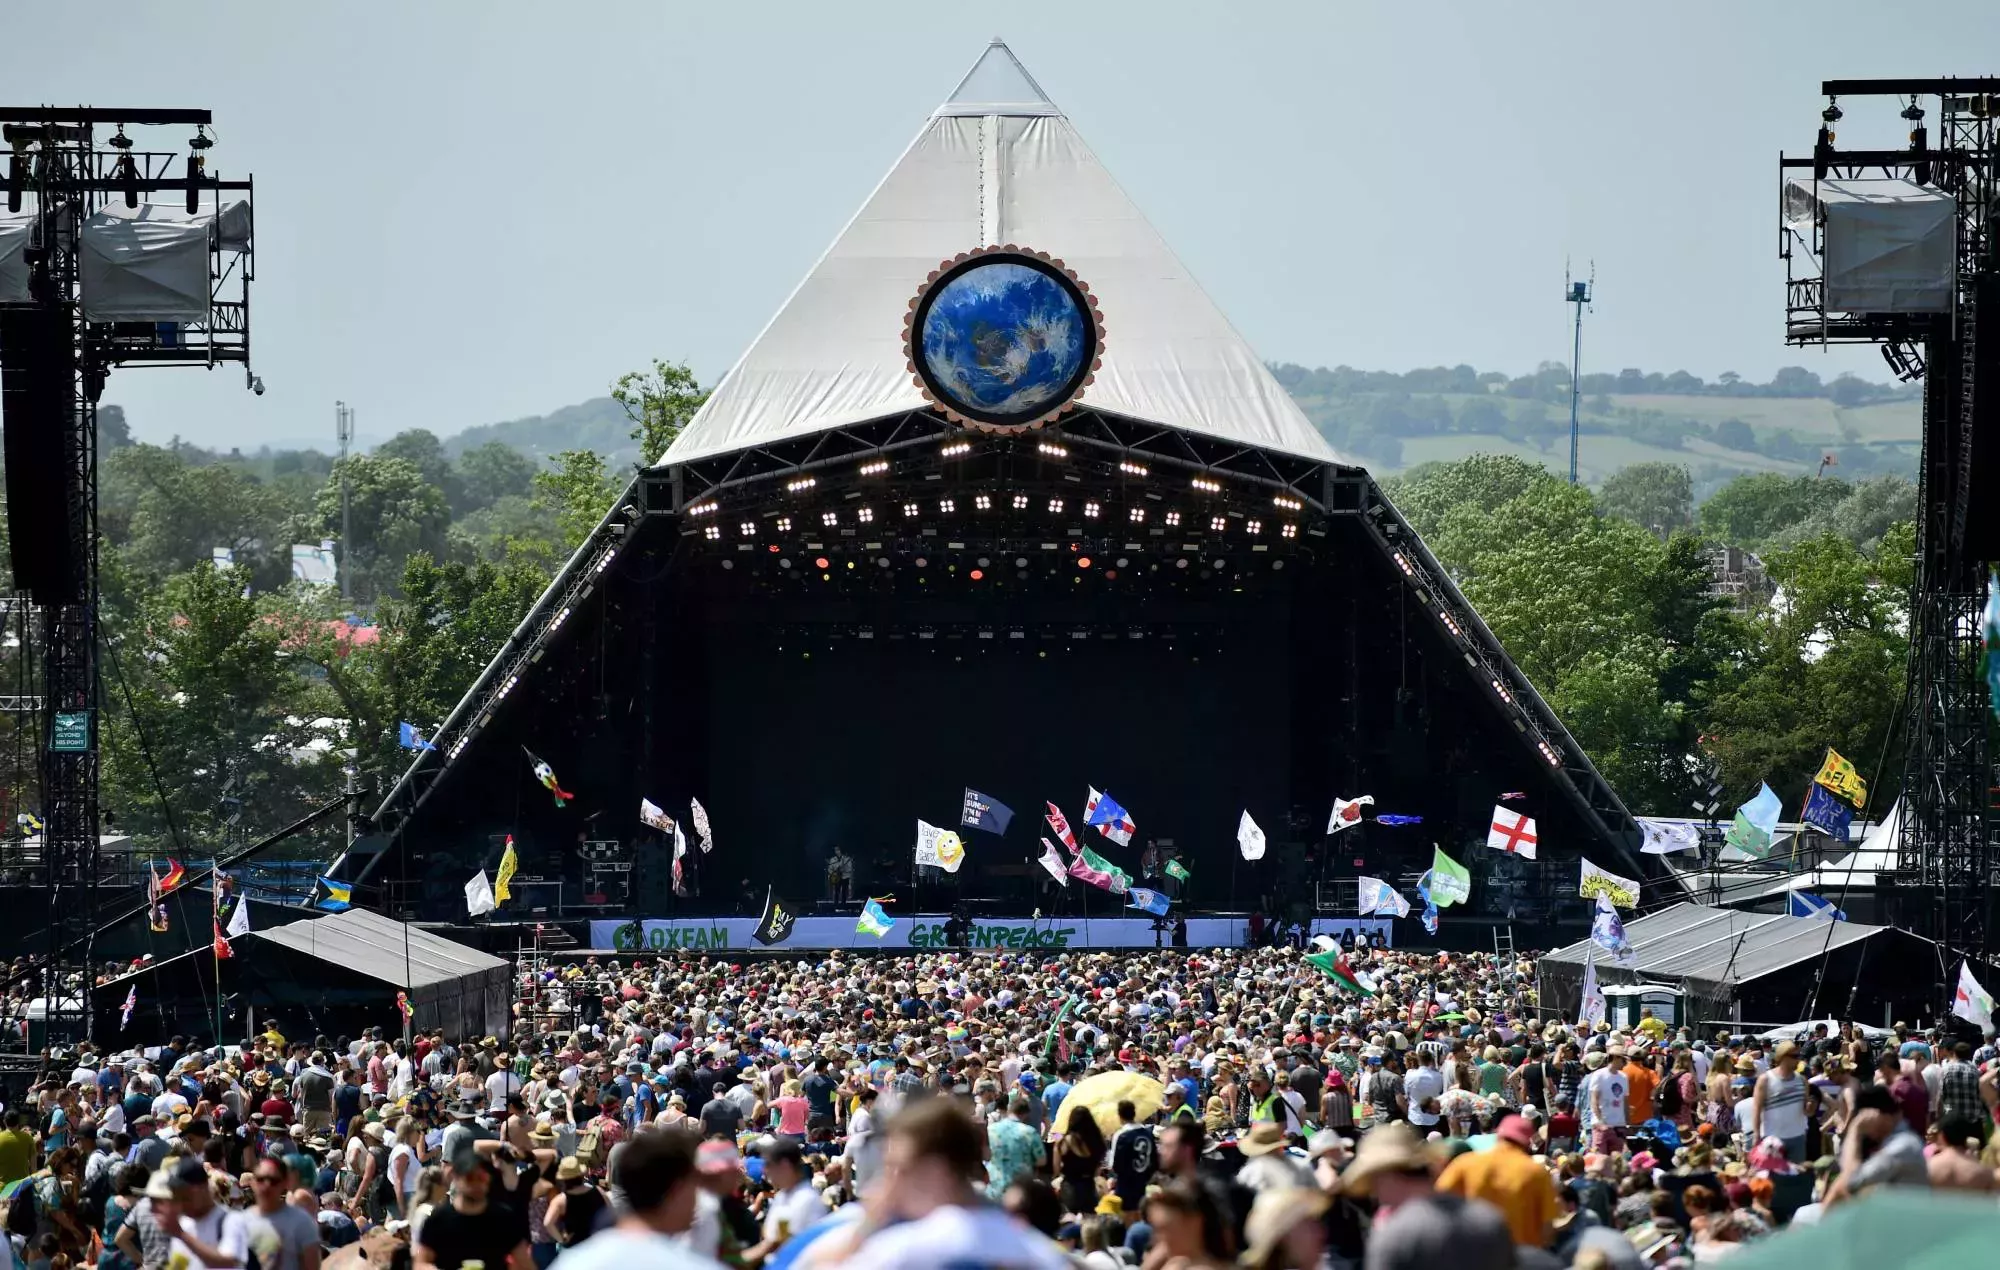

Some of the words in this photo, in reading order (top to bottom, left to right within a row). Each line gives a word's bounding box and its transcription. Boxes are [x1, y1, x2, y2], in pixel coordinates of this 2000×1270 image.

[966, 799, 990, 813] SUNDAY
[964, 815, 980, 825] LOVE
[1603, 878, 1622, 891] are
[650, 927, 728, 949] OXFAM
[908, 923, 1076, 949] GRENPEACE
[1133, 1135, 1152, 1173] 3
